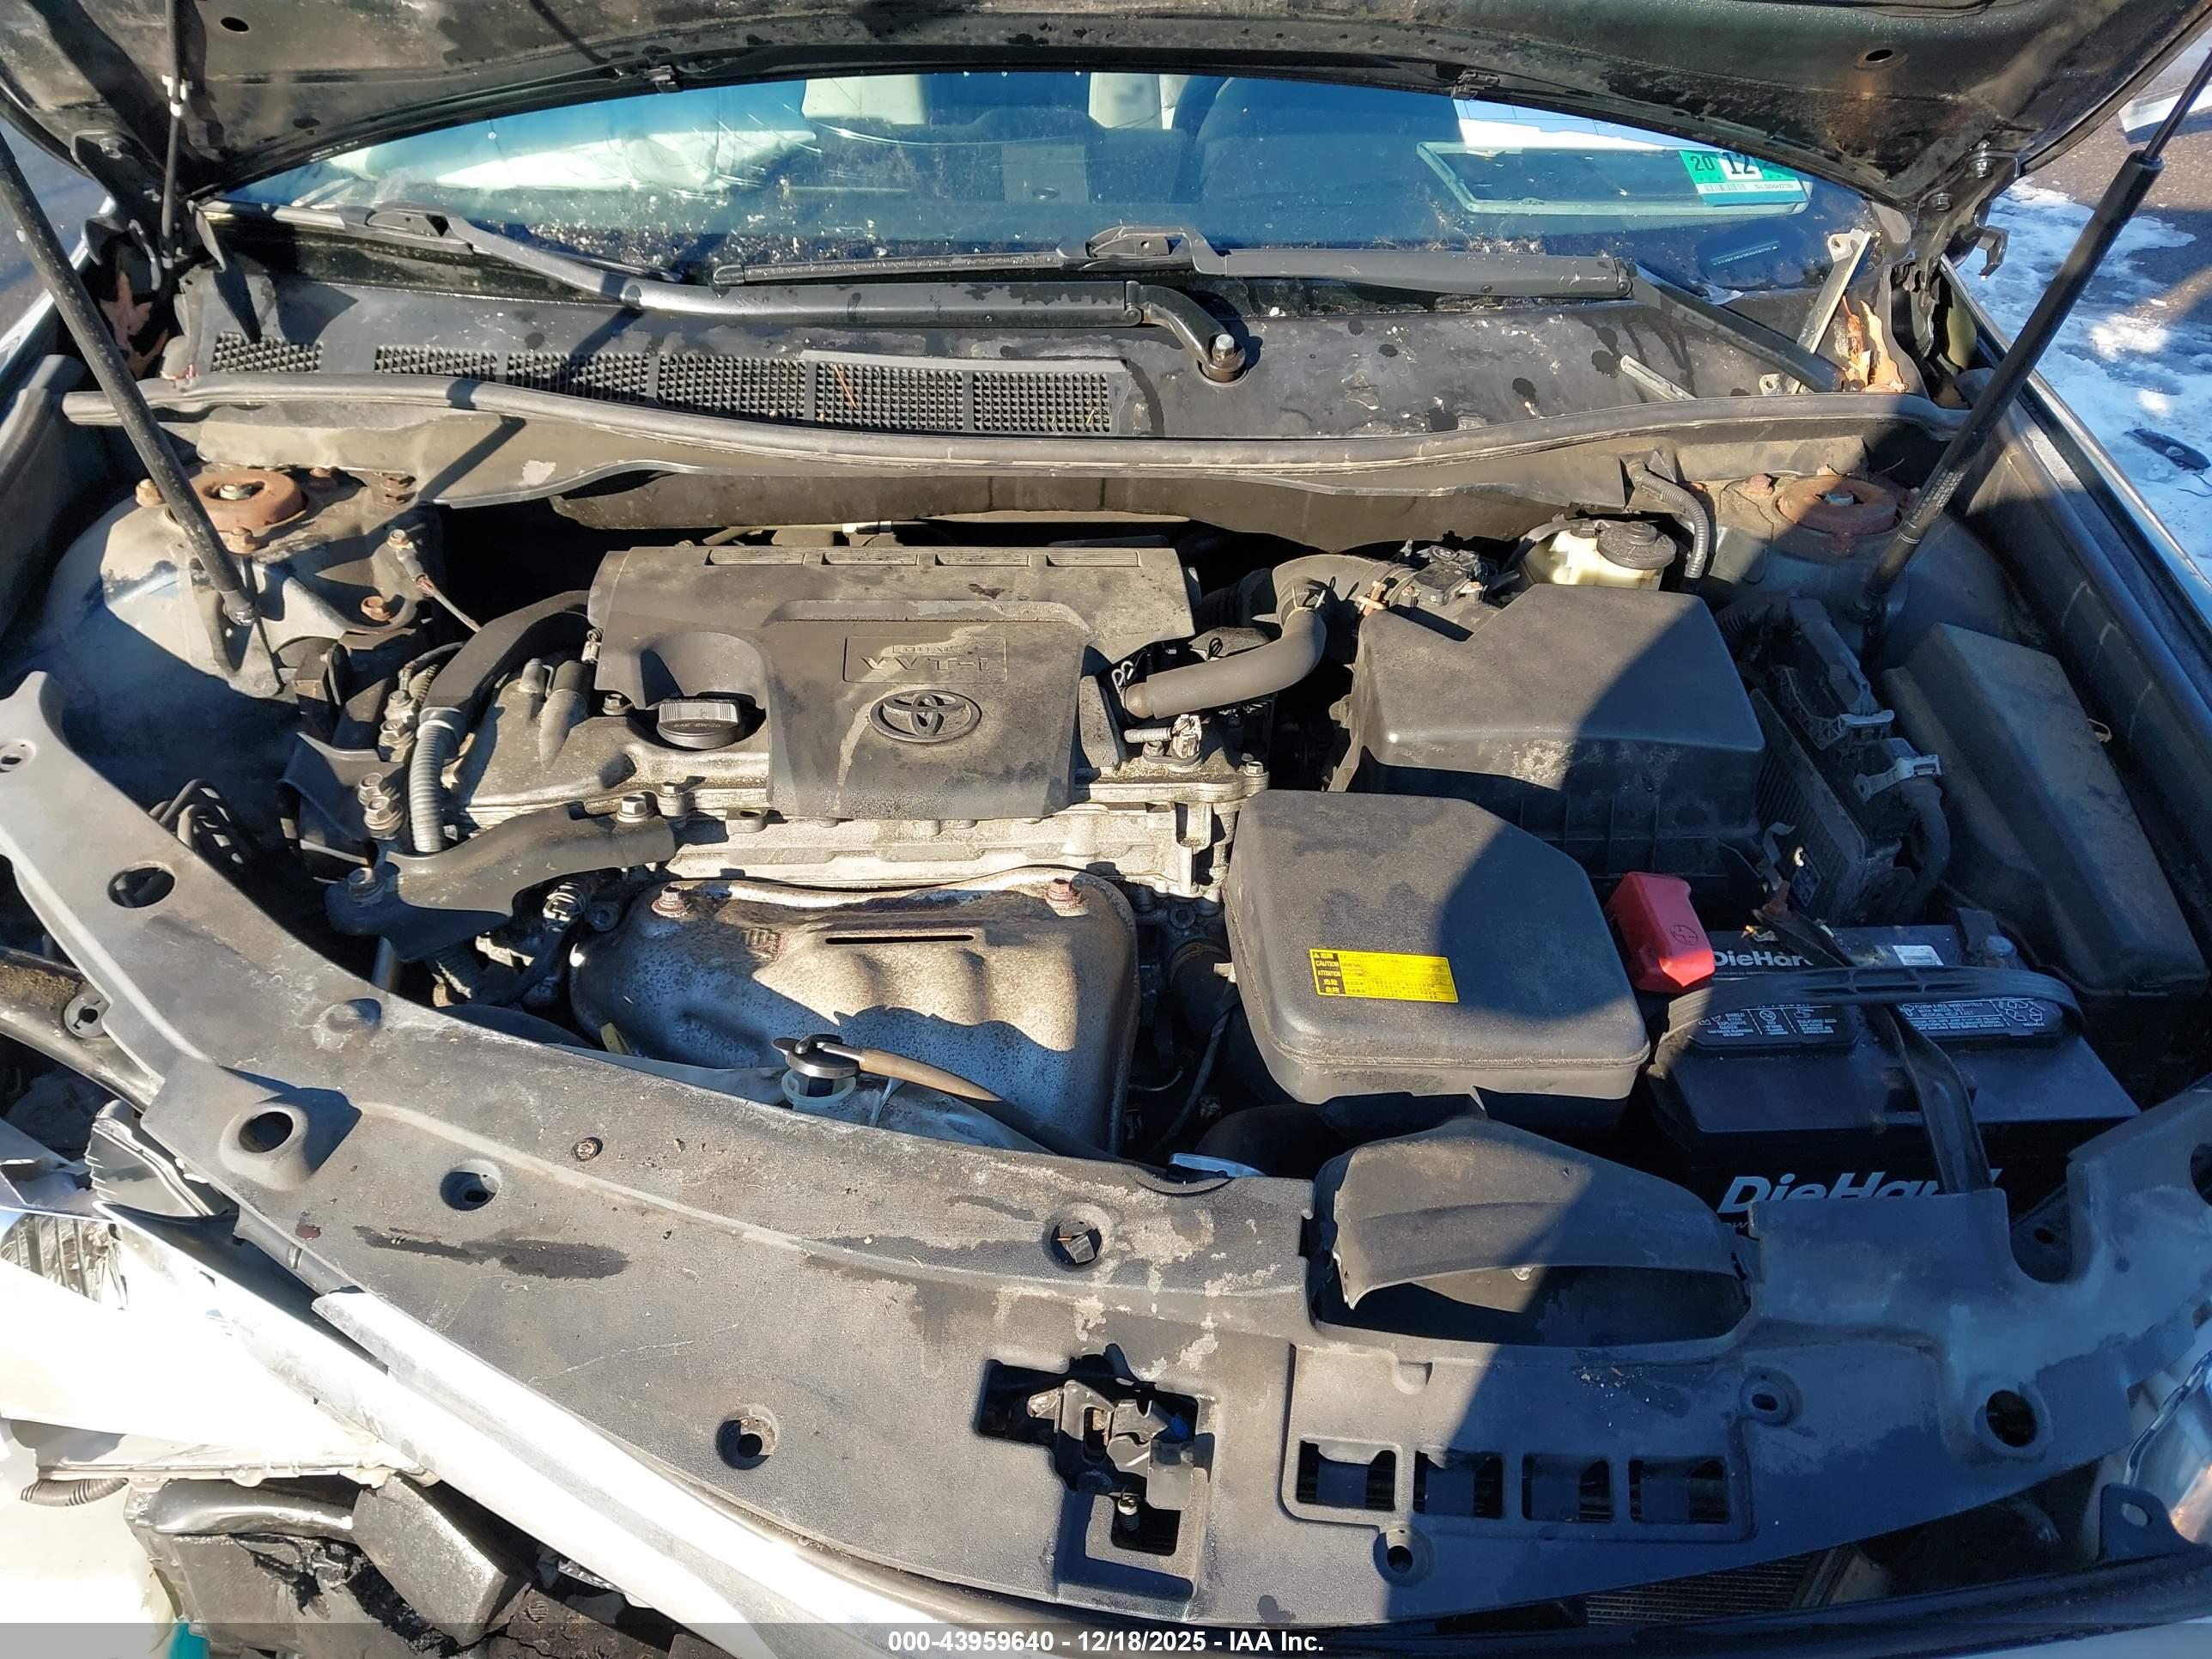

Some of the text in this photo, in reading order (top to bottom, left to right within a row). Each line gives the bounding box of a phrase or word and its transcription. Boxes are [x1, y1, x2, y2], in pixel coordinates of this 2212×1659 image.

[1690, 155, 1715, 171] 20
[1713, 950, 1814, 967] DieHar
[1717, 1169, 2003, 1213] DieHar
